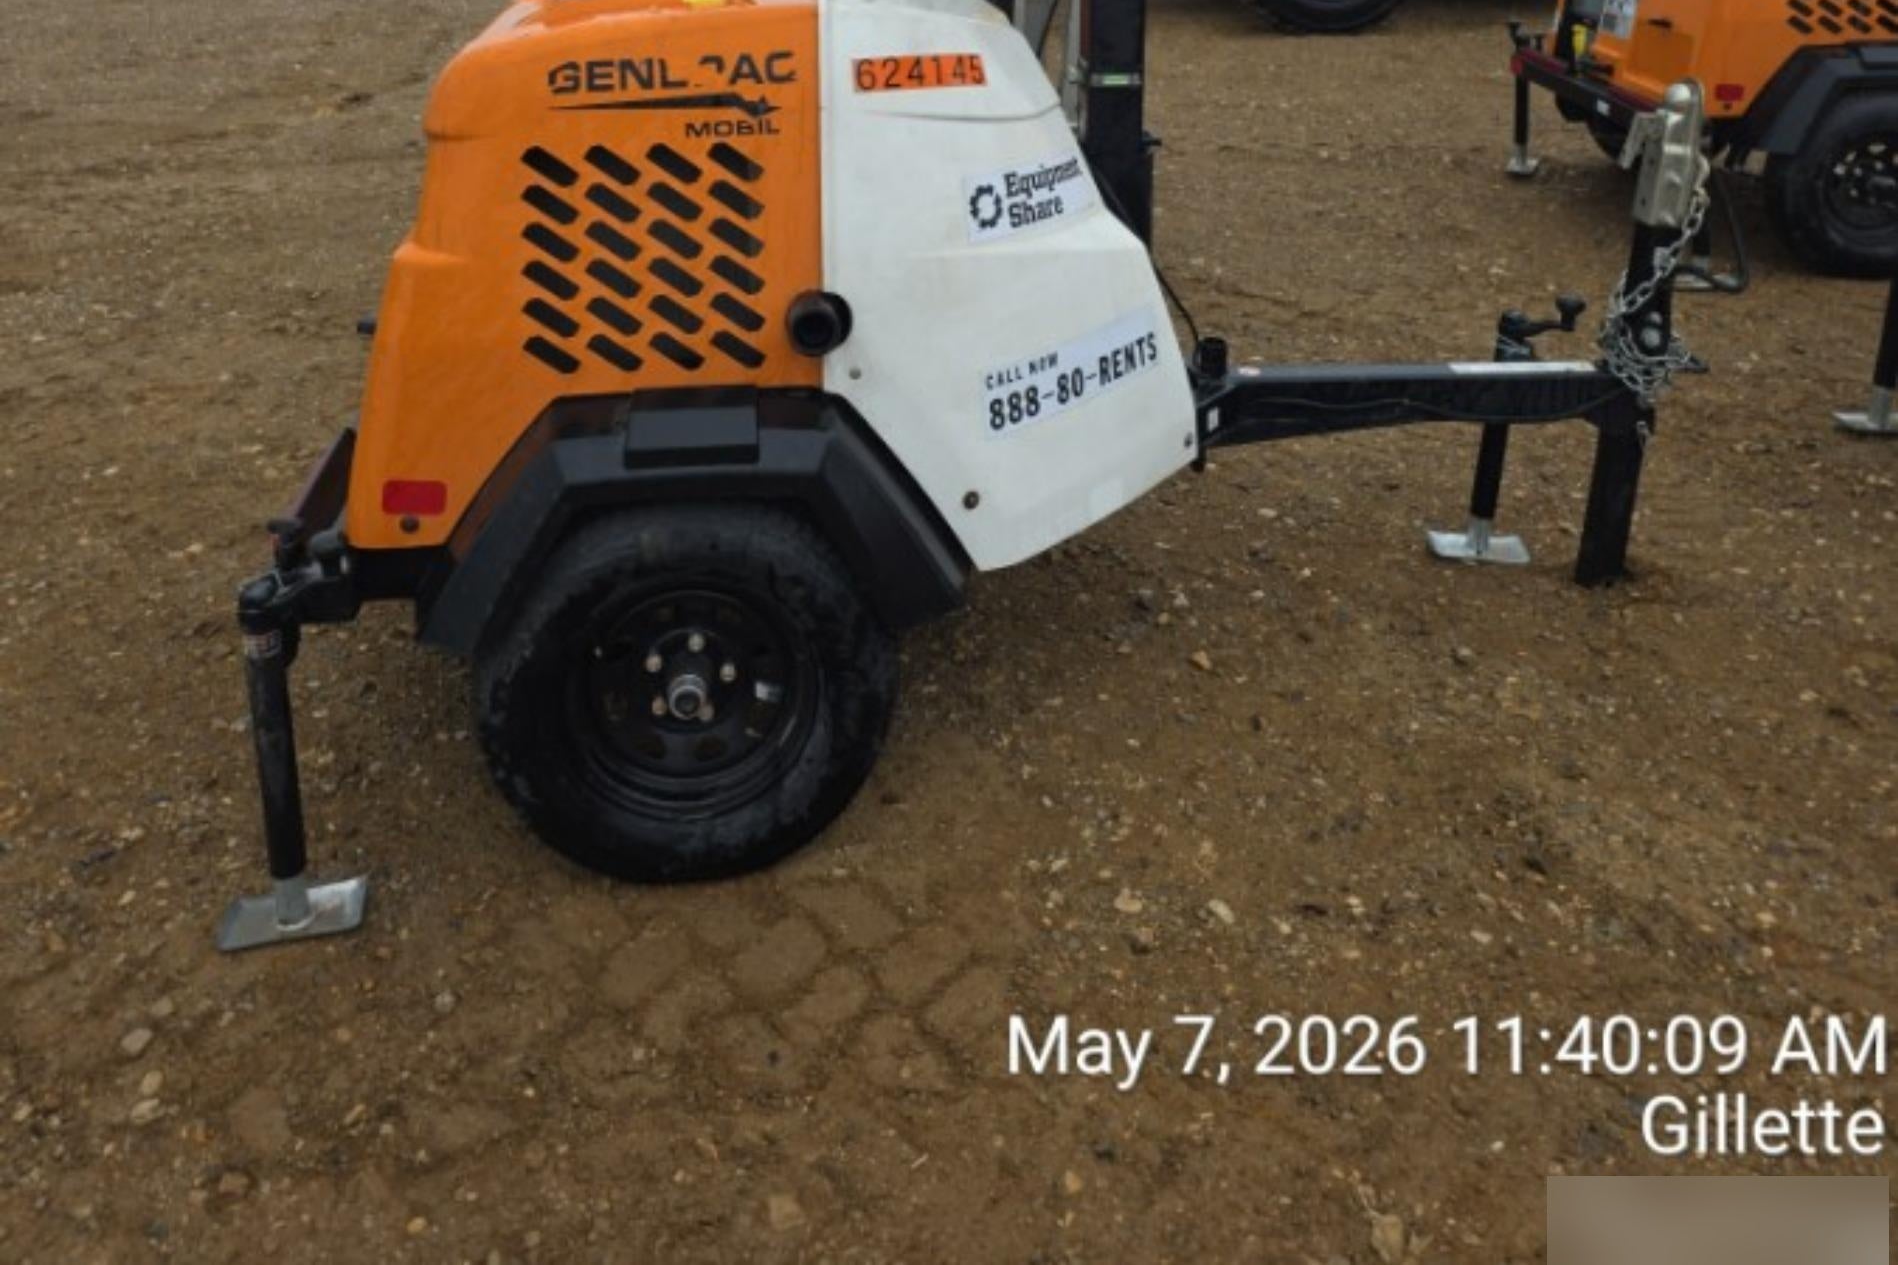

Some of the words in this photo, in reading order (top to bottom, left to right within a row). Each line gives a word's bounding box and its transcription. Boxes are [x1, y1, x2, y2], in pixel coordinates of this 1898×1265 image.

[857, 54, 986, 91] 624145
[1008, 195, 1063, 228] Share
[985, 366, 1024, 391] CALL
[1029, 350, 1059, 376] NOW
[989, 331, 1158, 431] 888-80-RENTS
